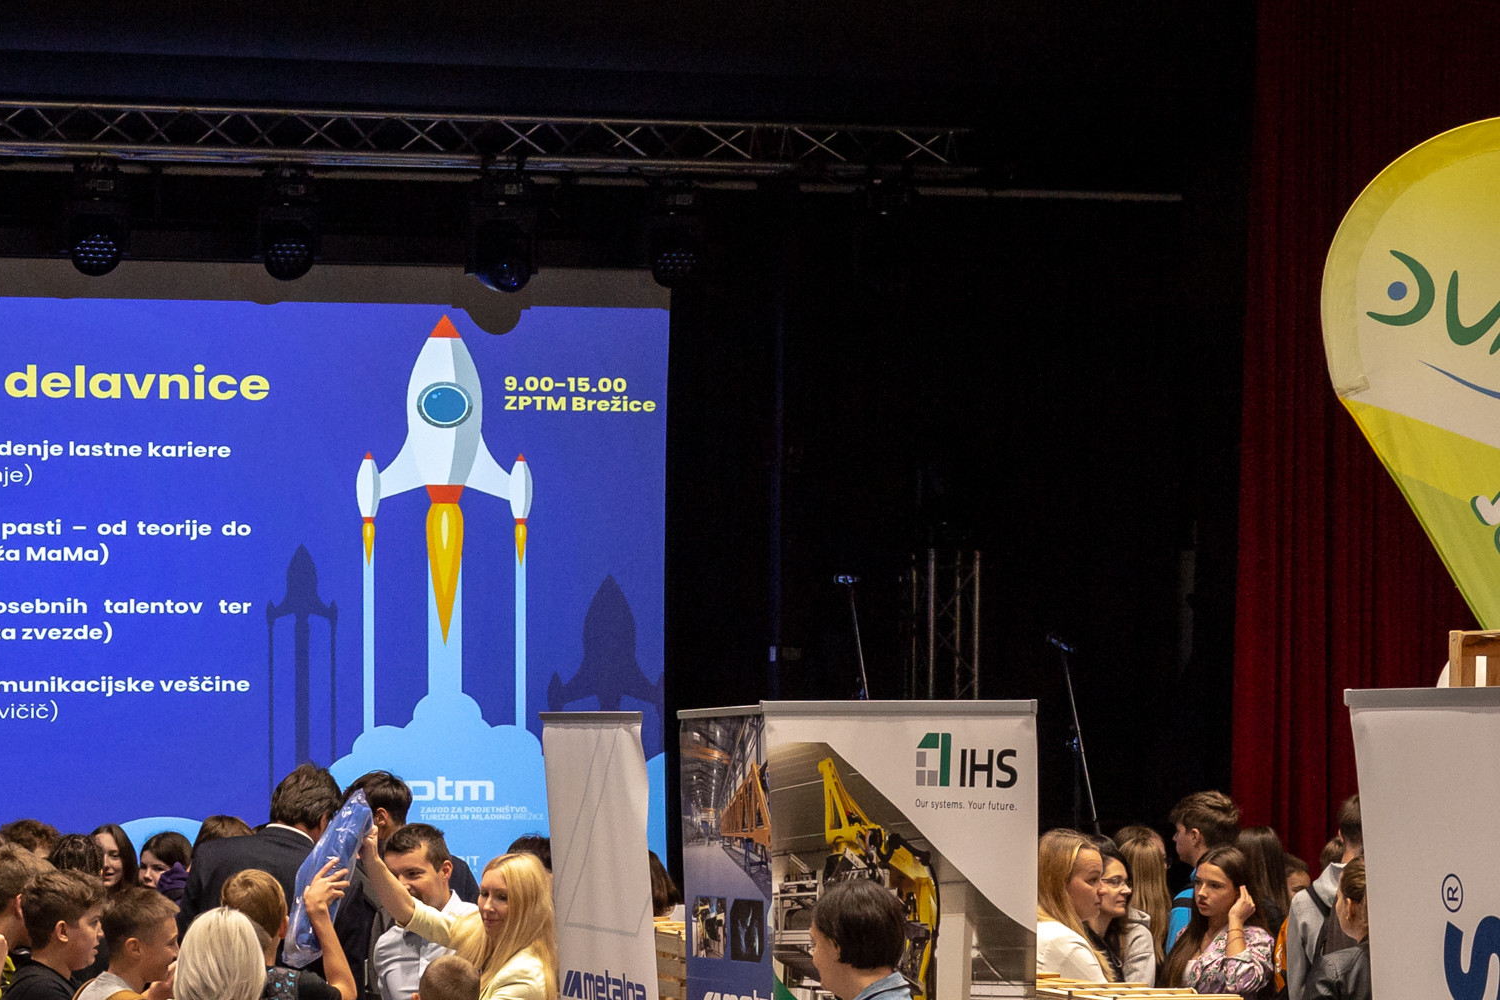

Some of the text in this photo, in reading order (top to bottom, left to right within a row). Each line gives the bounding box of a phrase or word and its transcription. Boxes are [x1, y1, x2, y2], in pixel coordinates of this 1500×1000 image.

[4, 363, 269, 400] delavnice
[504, 395, 656, 412] ZPTM Brežice
[68, 440, 142, 456] lastne
[147, 440, 231, 457] kariere
[1, 518, 61, 539] pasti
[97, 519, 126, 535] od
[136, 519, 211, 540] teorije
[221, 520, 251, 536] do
[26, 542, 108, 565] MaMa)
[103, 598, 202, 613] talentov
[218, 599, 251, 614] ter
[21, 621, 112, 643] zvezde)
[159, 675, 250, 692] veščine
[959, 748, 1018, 789] IHS
[420, 806, 449, 814] ZAVOD
[451, 806, 462, 814] ZA
[914, 798, 1018, 811] Our systems. Your future.
[421, 813, 459, 821] TURIZEM
[460, 813, 470, 821] IN
